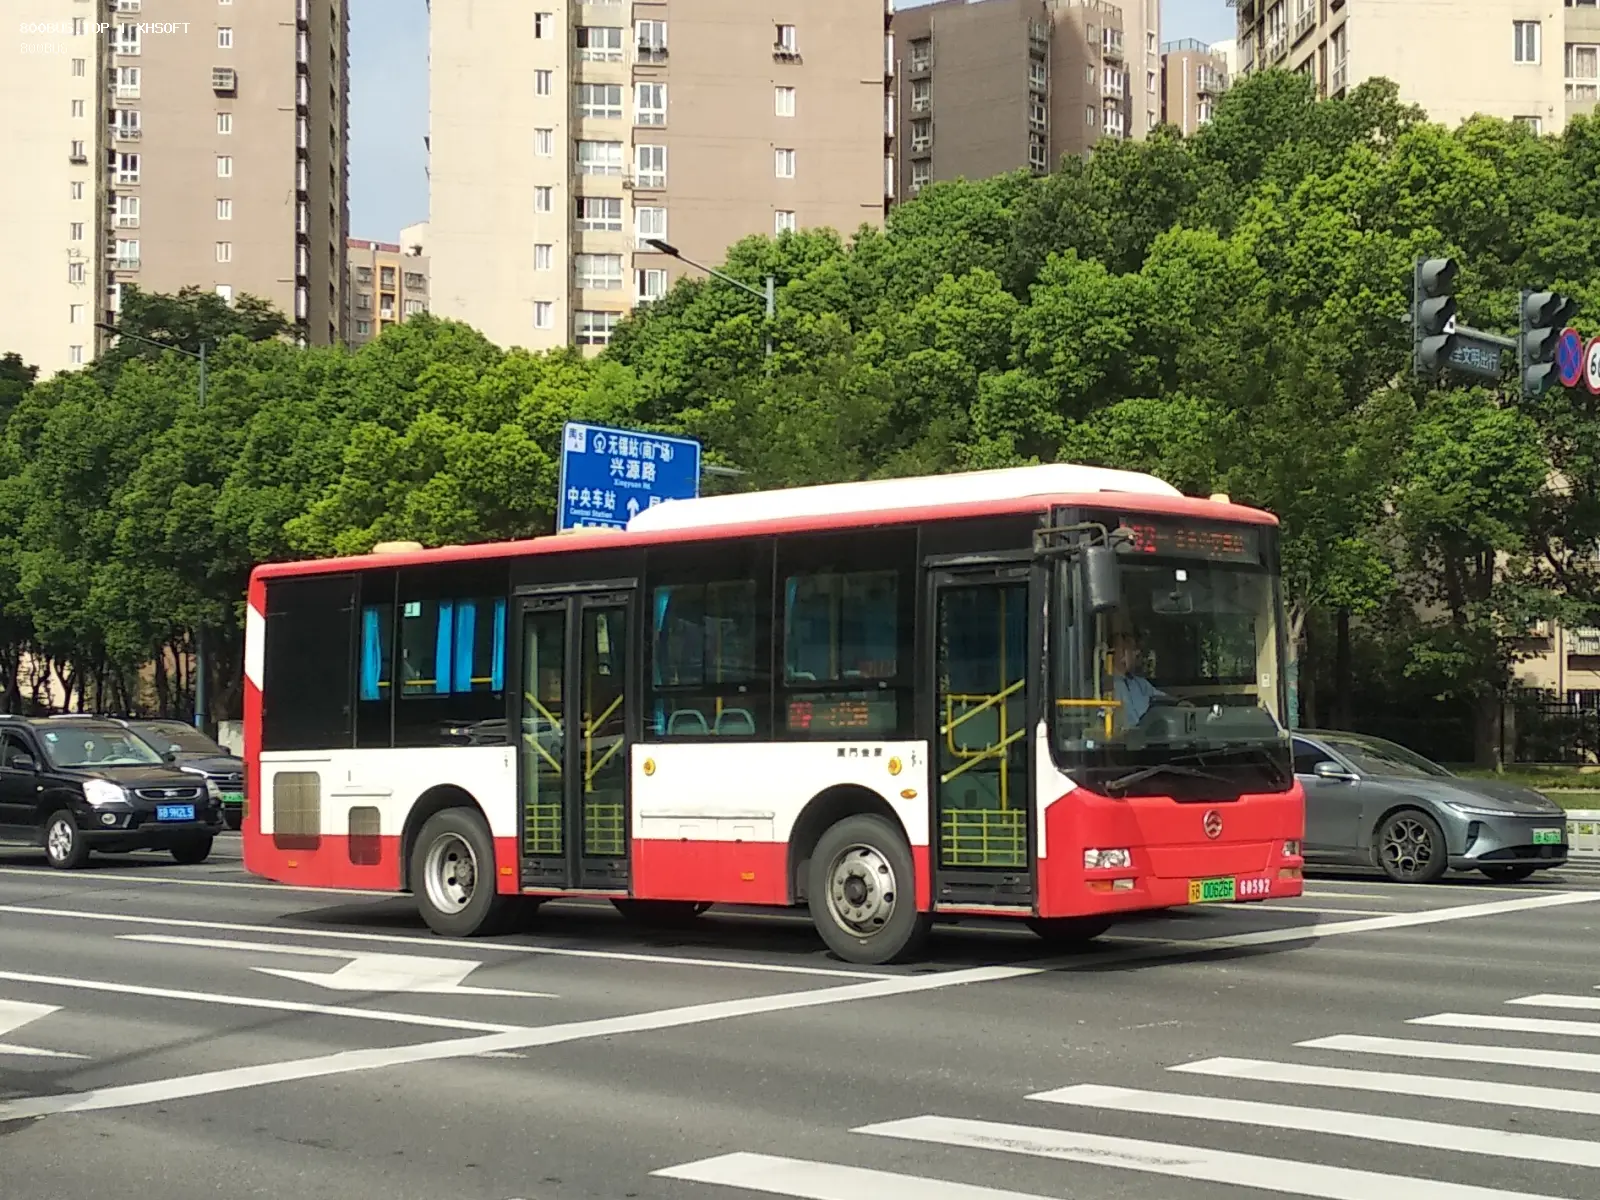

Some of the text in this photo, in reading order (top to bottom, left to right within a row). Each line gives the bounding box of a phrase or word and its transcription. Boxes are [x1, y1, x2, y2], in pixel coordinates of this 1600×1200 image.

[1450, 347, 1497, 371] 全文明出行
[610, 457, 656, 482] 兴源路
[567, 486, 616, 510] 中央车站
[1240, 878, 1270, 895] 60592
